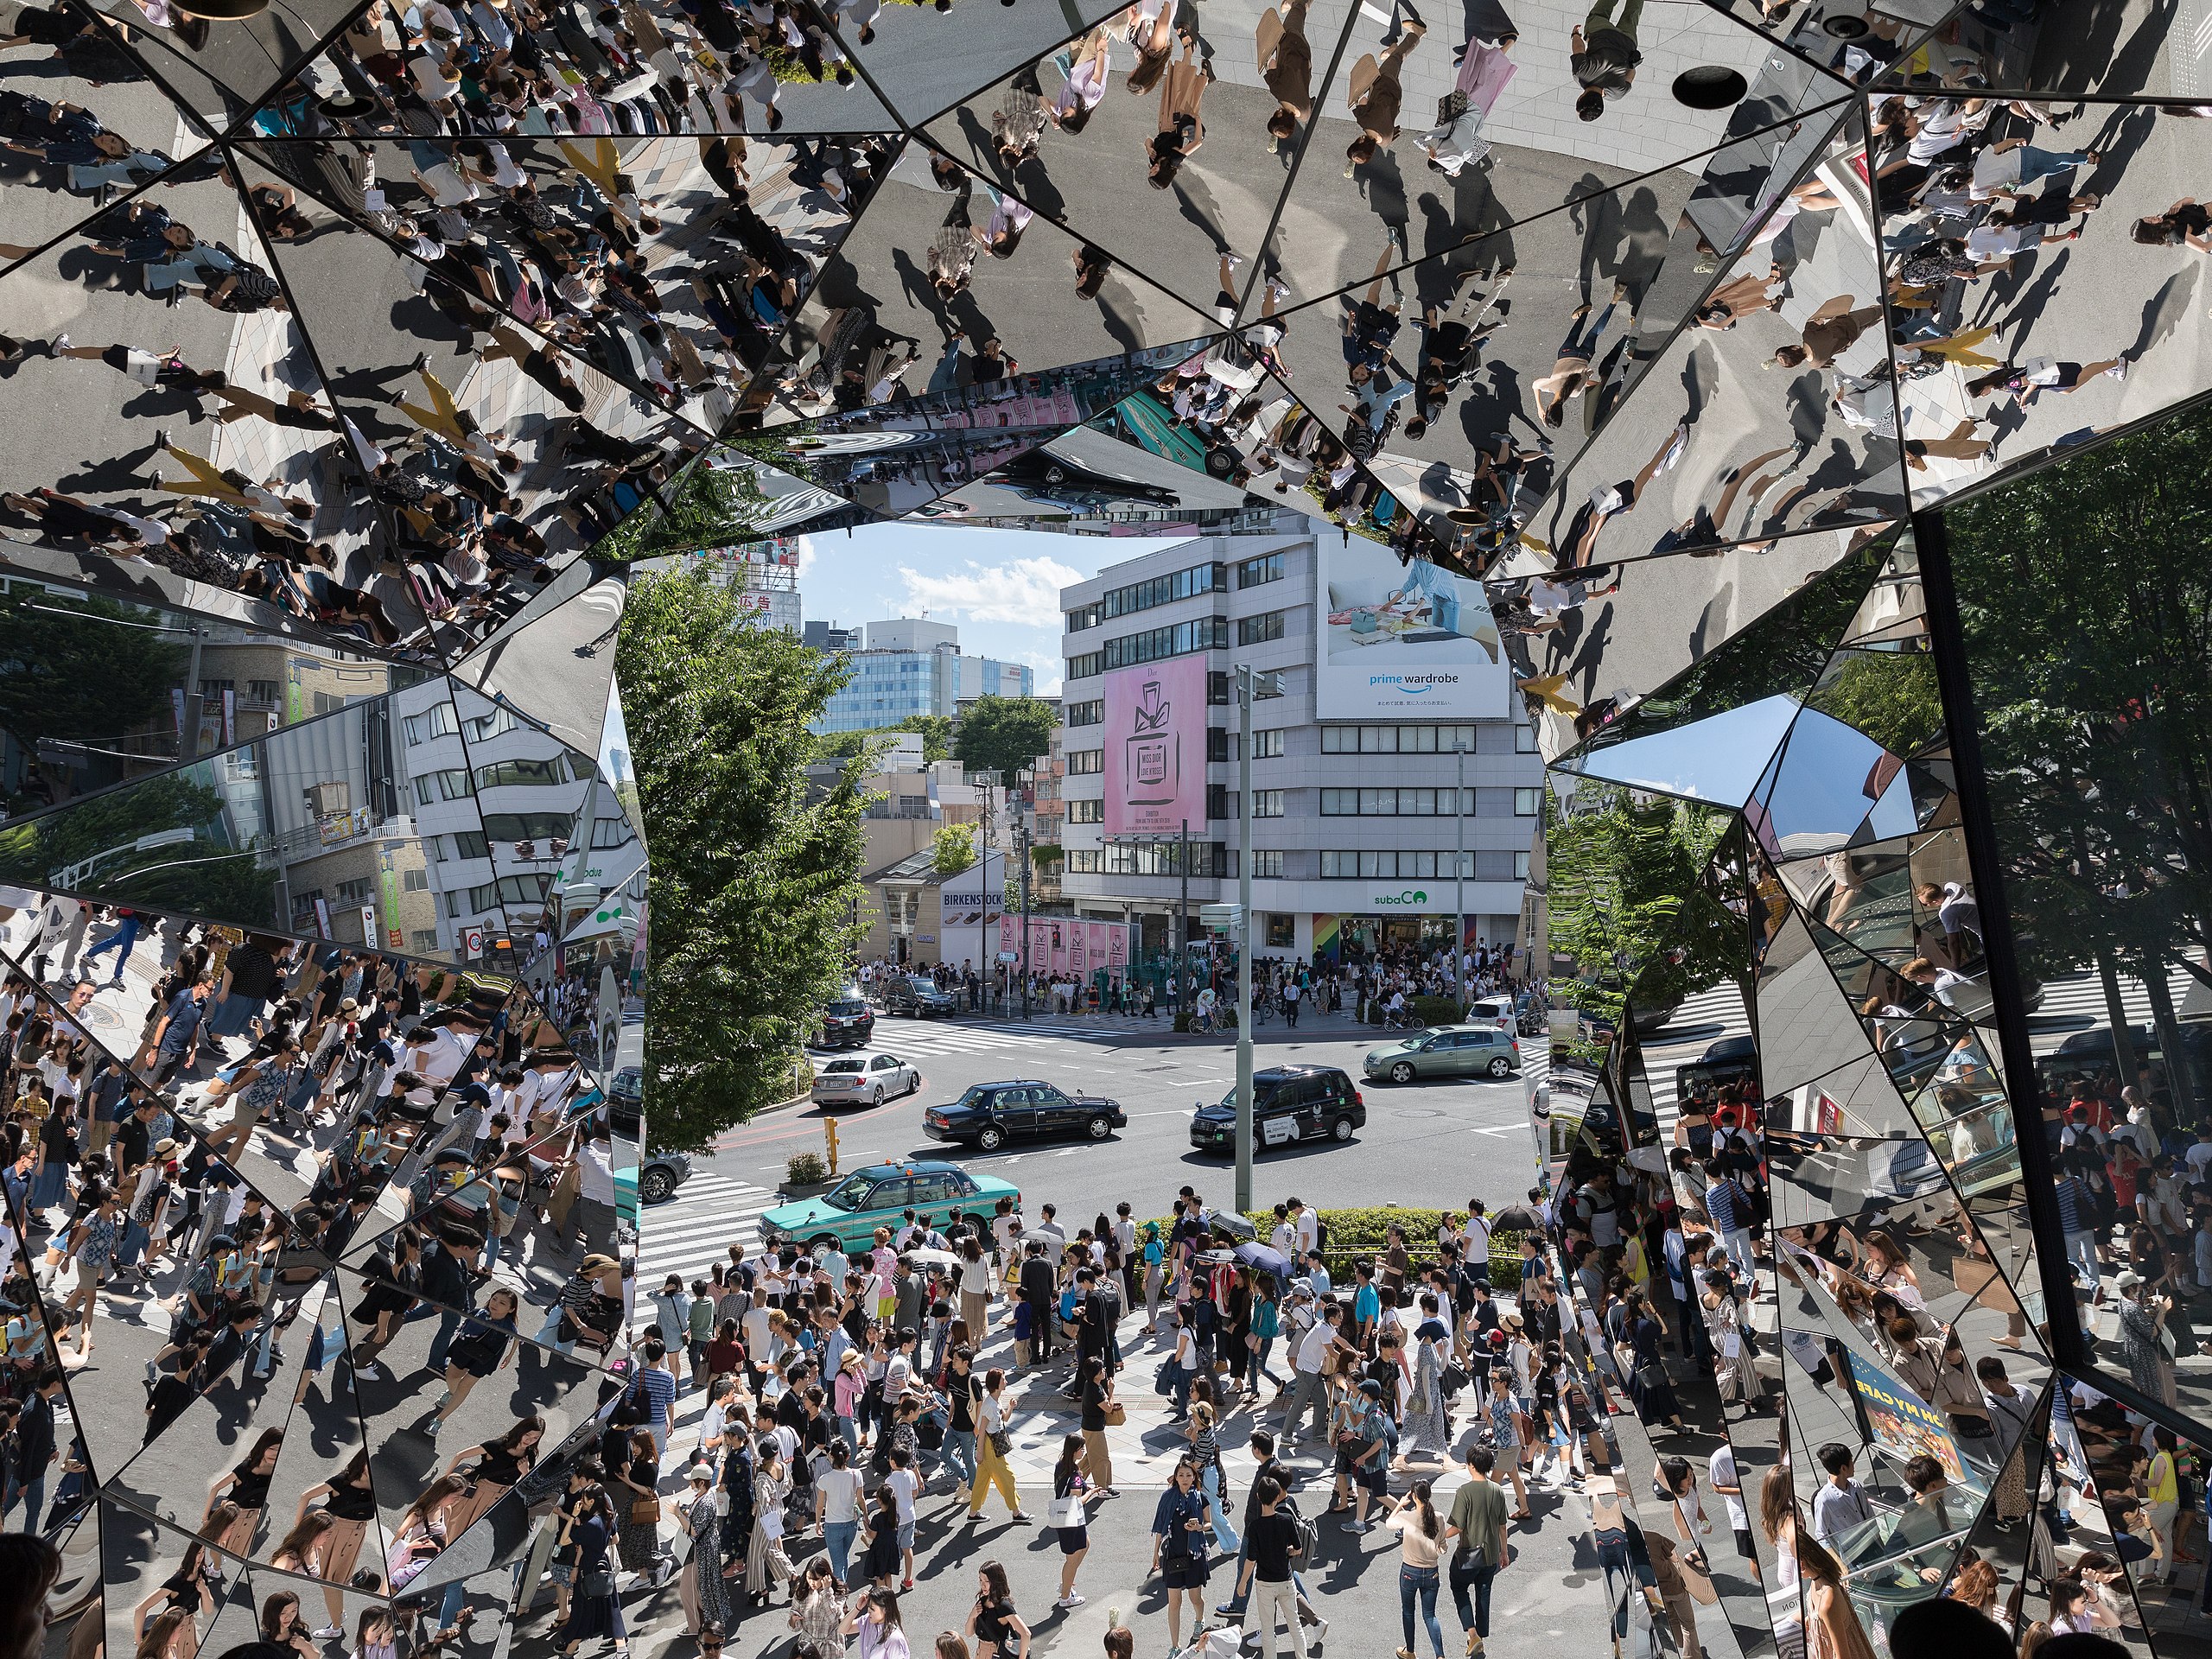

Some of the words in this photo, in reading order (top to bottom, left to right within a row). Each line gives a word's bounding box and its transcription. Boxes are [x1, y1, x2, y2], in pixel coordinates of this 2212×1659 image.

[740, 594, 771, 610] 広告
[1147, 668, 1158, 677] Dior
[1370, 674, 1402, 686] prime
[1404, 673, 1459, 683] wardrobe
[1141, 753, 1152, 764] MISS
[1152, 753, 1162, 763] DIOR
[1141, 767, 1149, 776] LOVE
[1823, 1102, 1835, 1133] FREE
